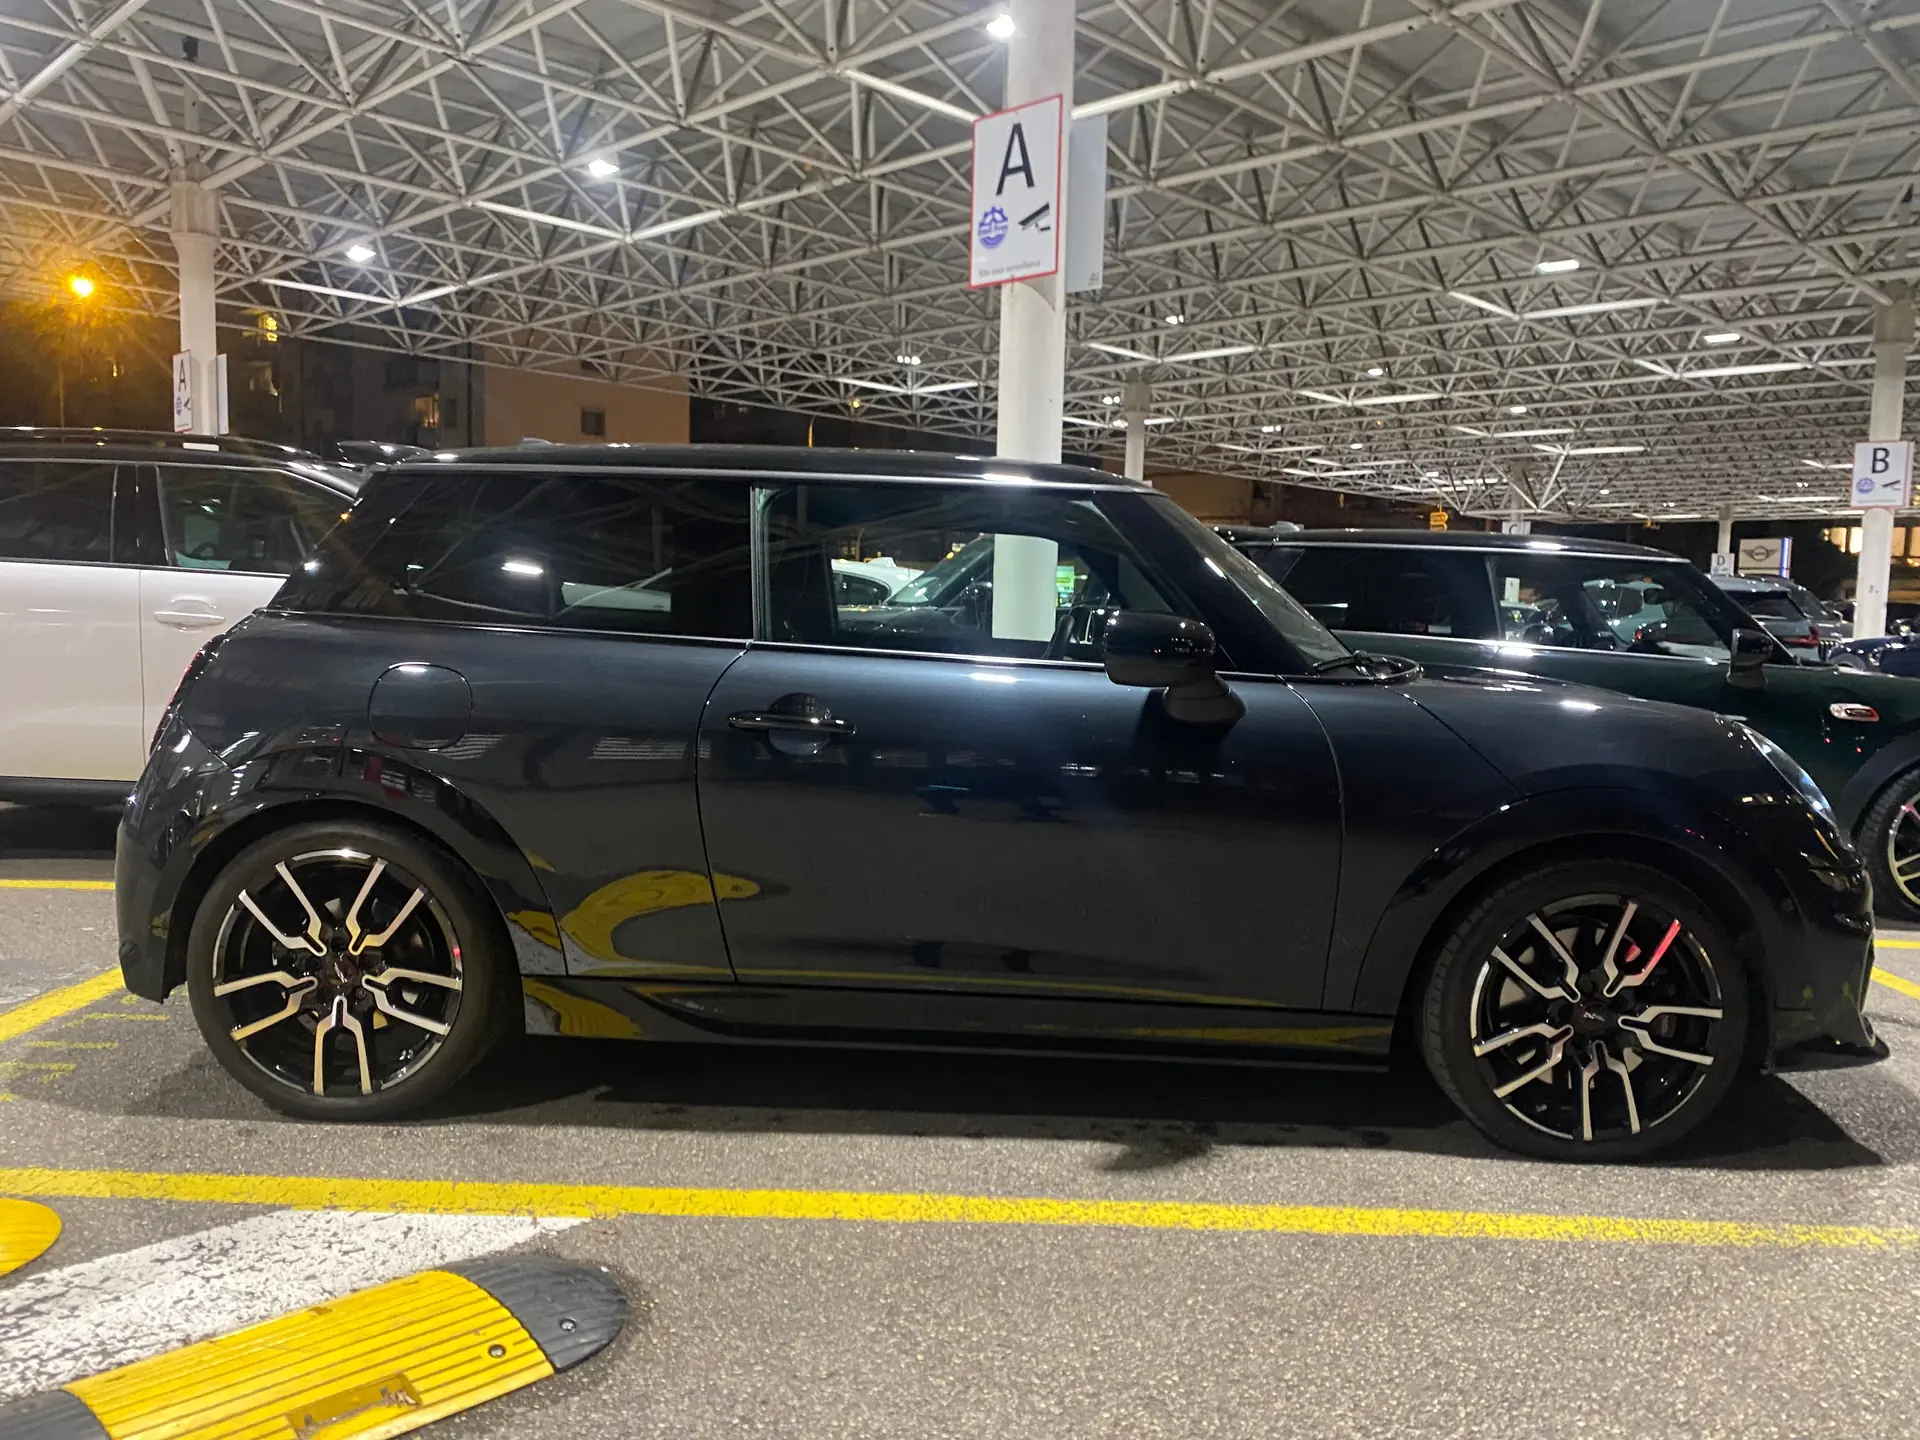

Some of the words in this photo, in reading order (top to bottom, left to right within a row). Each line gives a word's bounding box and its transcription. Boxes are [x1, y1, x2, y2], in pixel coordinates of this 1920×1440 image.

[995, 122, 1035, 196] A
[178, 359, 187, 392] A
[1872, 447, 1890, 474] B
[1717, 555, 1725, 566] D
